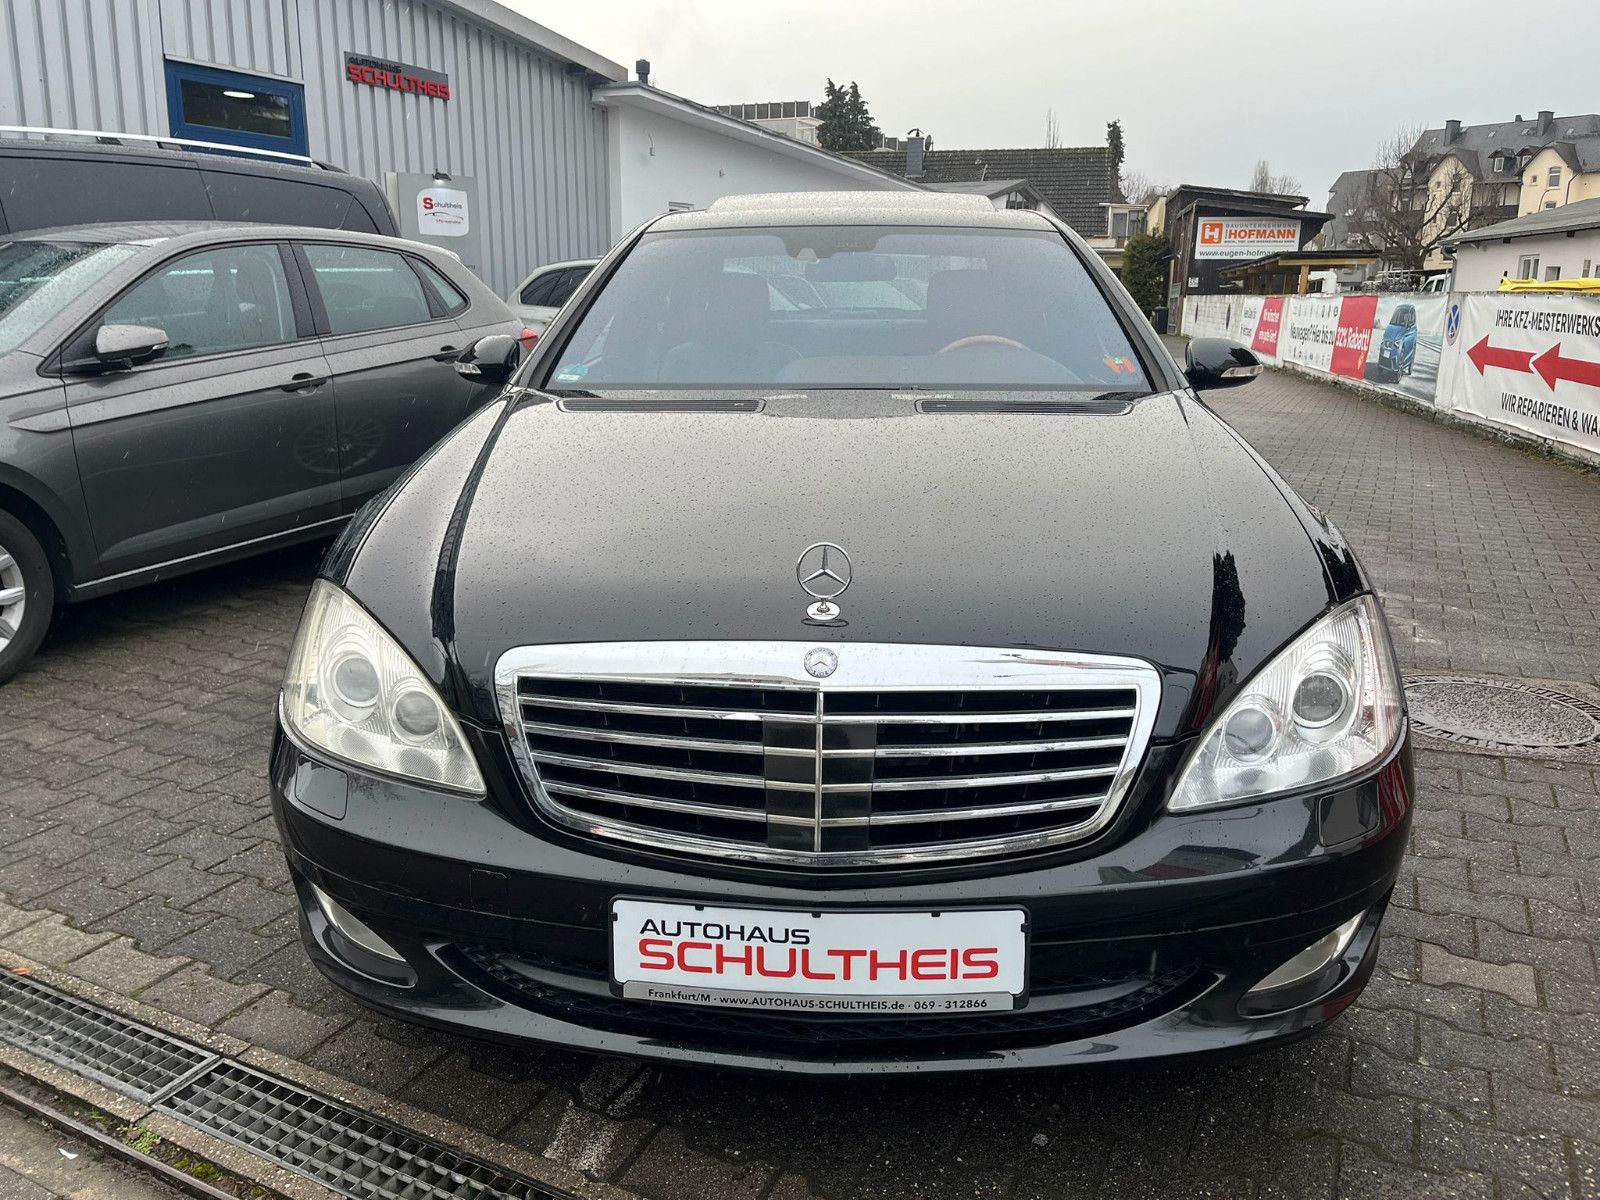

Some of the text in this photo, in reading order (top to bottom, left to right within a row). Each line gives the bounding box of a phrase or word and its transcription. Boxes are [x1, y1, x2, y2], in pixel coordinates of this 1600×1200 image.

[348, 64, 450, 100] SCHULTHEIS
[423, 197, 463, 210] Schultheis
[1228, 229, 1296, 239] HOFMANN
[1495, 309, 1512, 328] IHRE
[1501, 392, 1600, 438] WIR REPARIEREN & WA
[639, 918, 811, 945] AUTOHAUS
[638, 938, 1000, 981] SCHULTHEIS
[648, 988, 711, 1003] Frankfurt/M
[719, 997, 905, 1010] www.AUTOHAUS-SCHULTHEIS.de
[913, 1001, 936, 1010] 069
[944, 999, 988, 1009] 312866
